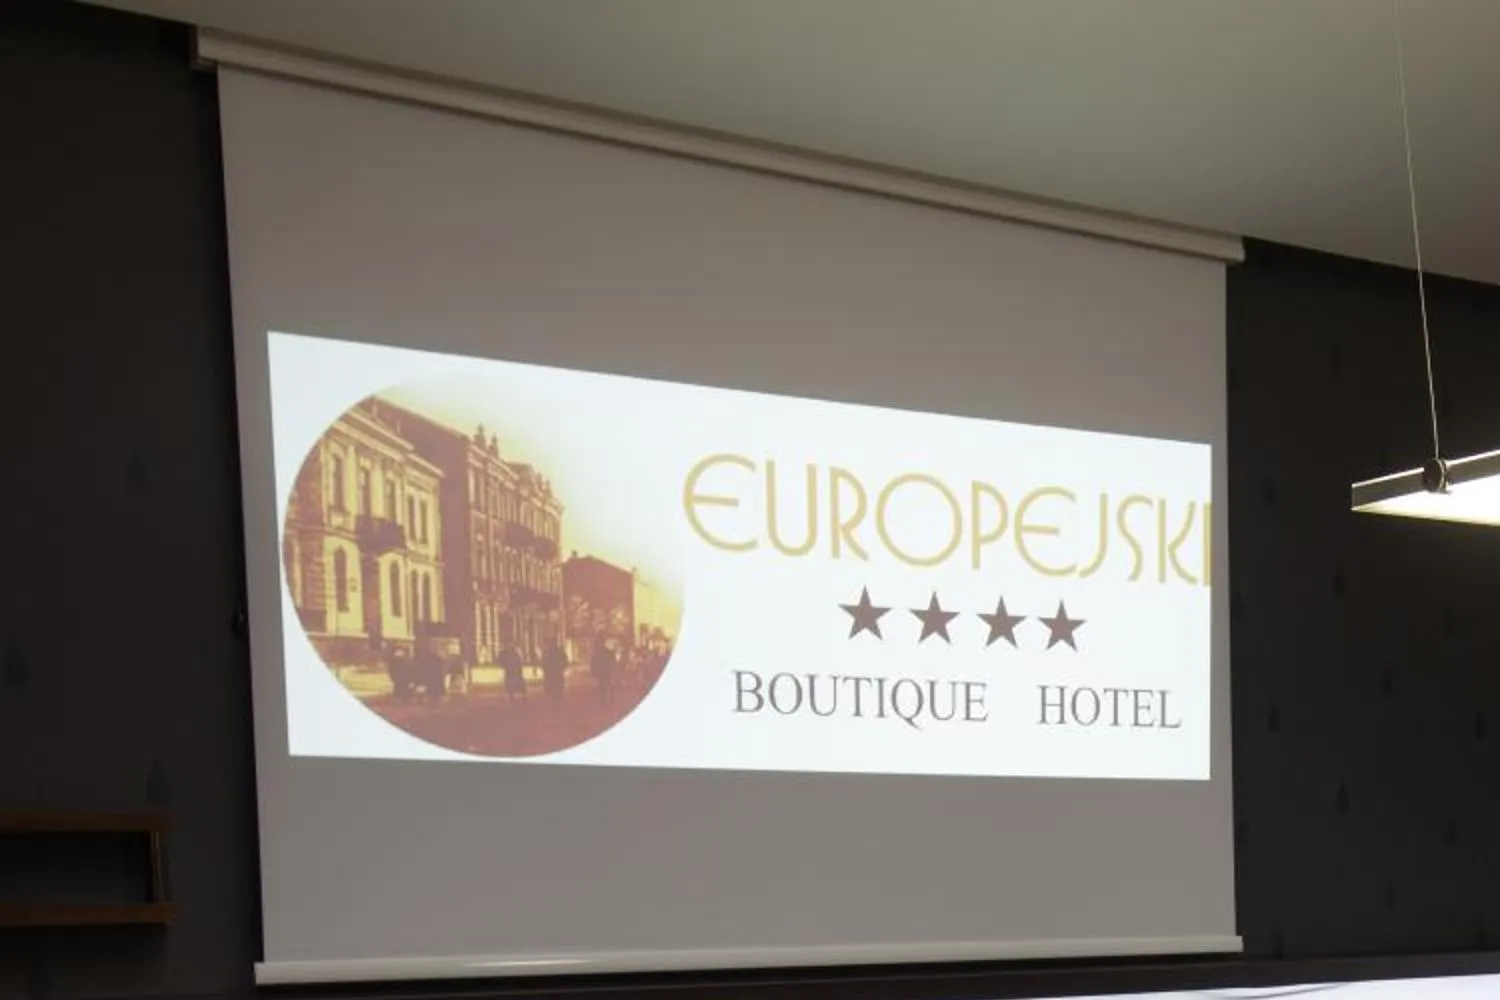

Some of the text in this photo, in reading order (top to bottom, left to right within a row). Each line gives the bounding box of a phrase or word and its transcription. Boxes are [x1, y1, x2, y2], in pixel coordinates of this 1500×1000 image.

[684, 453, 1212, 586] EUROPEJSKI
[733, 670, 1182, 729] BOUTIQUE HOTEL
